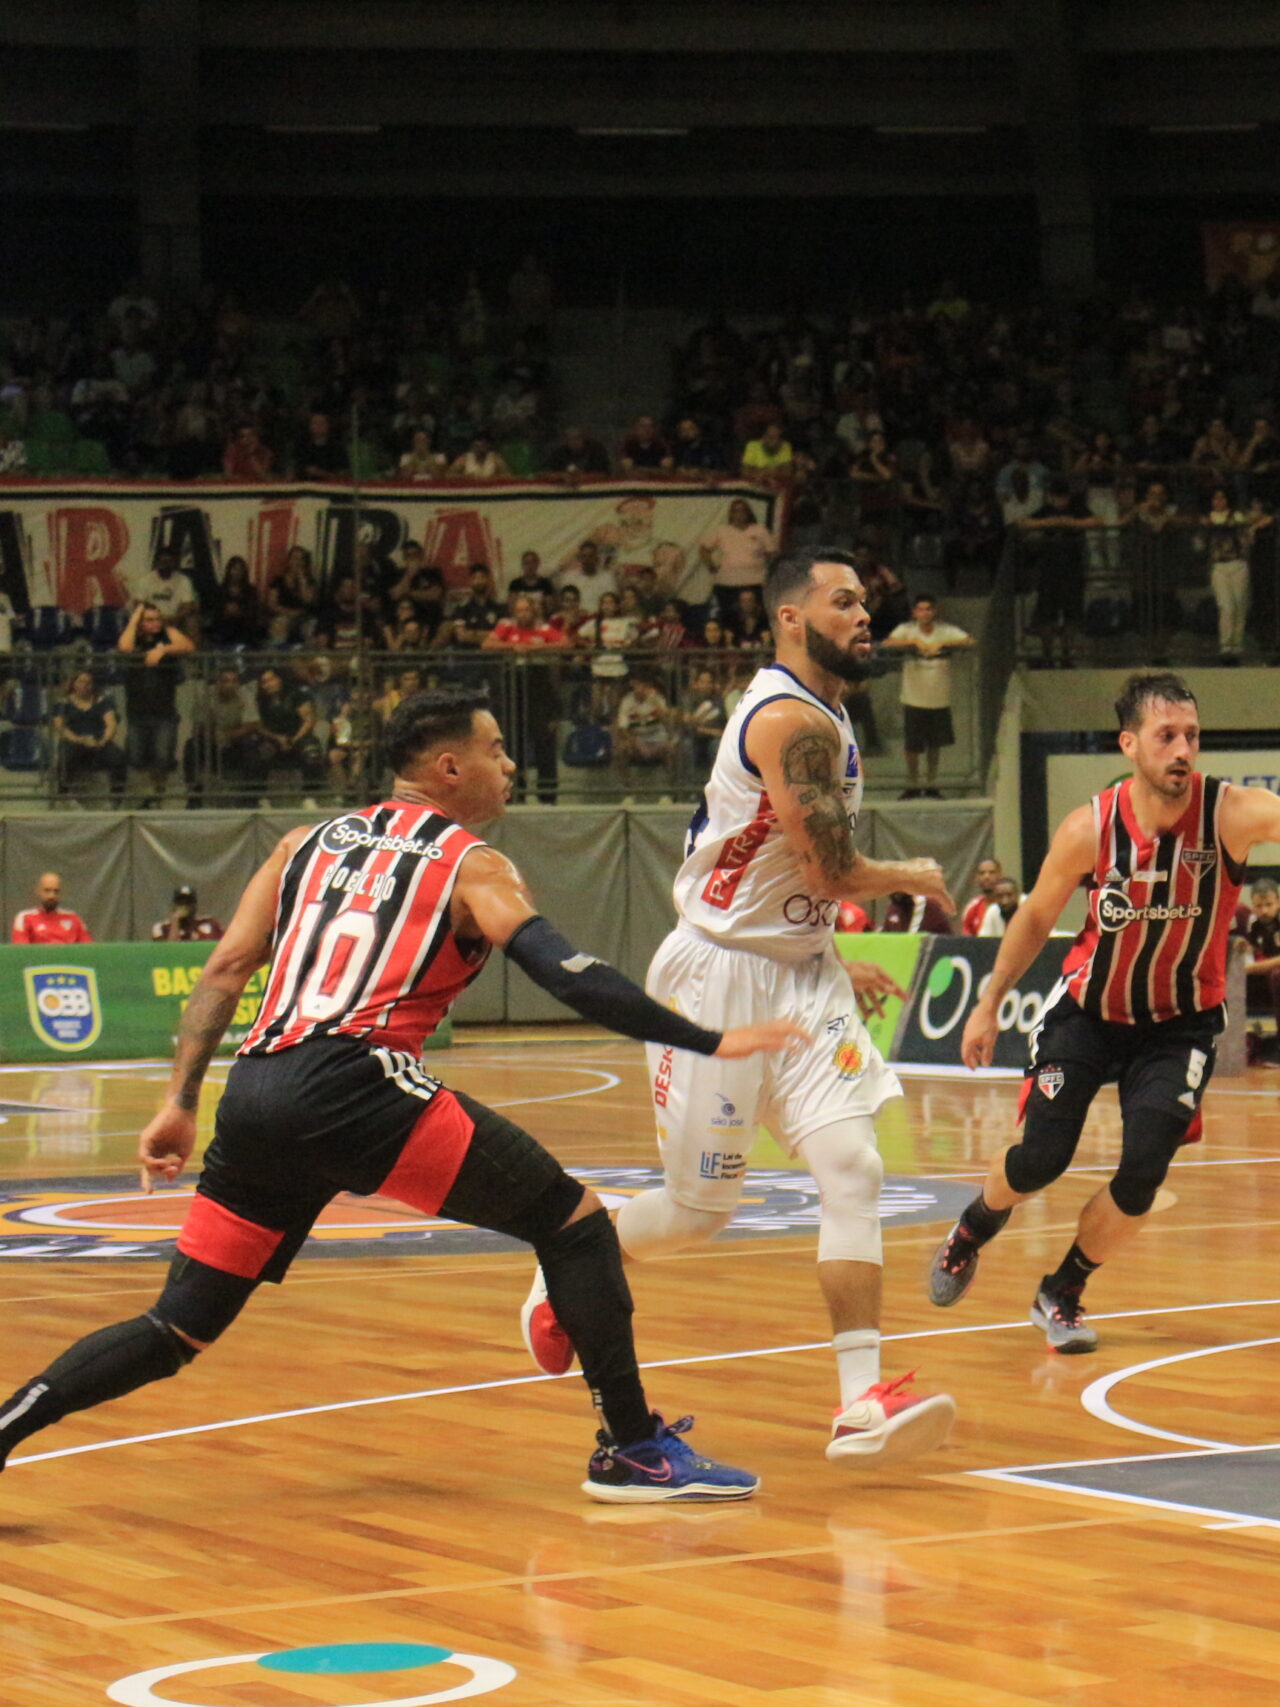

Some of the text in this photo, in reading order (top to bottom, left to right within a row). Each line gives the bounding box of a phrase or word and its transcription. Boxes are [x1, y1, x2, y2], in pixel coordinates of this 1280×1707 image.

[332, 823, 444, 860] Sportsbet.io
[320, 864, 397, 901] COELHO
[1102, 901, 1202, 922] Sportsbet.io
[272, 900, 380, 1022] 10
